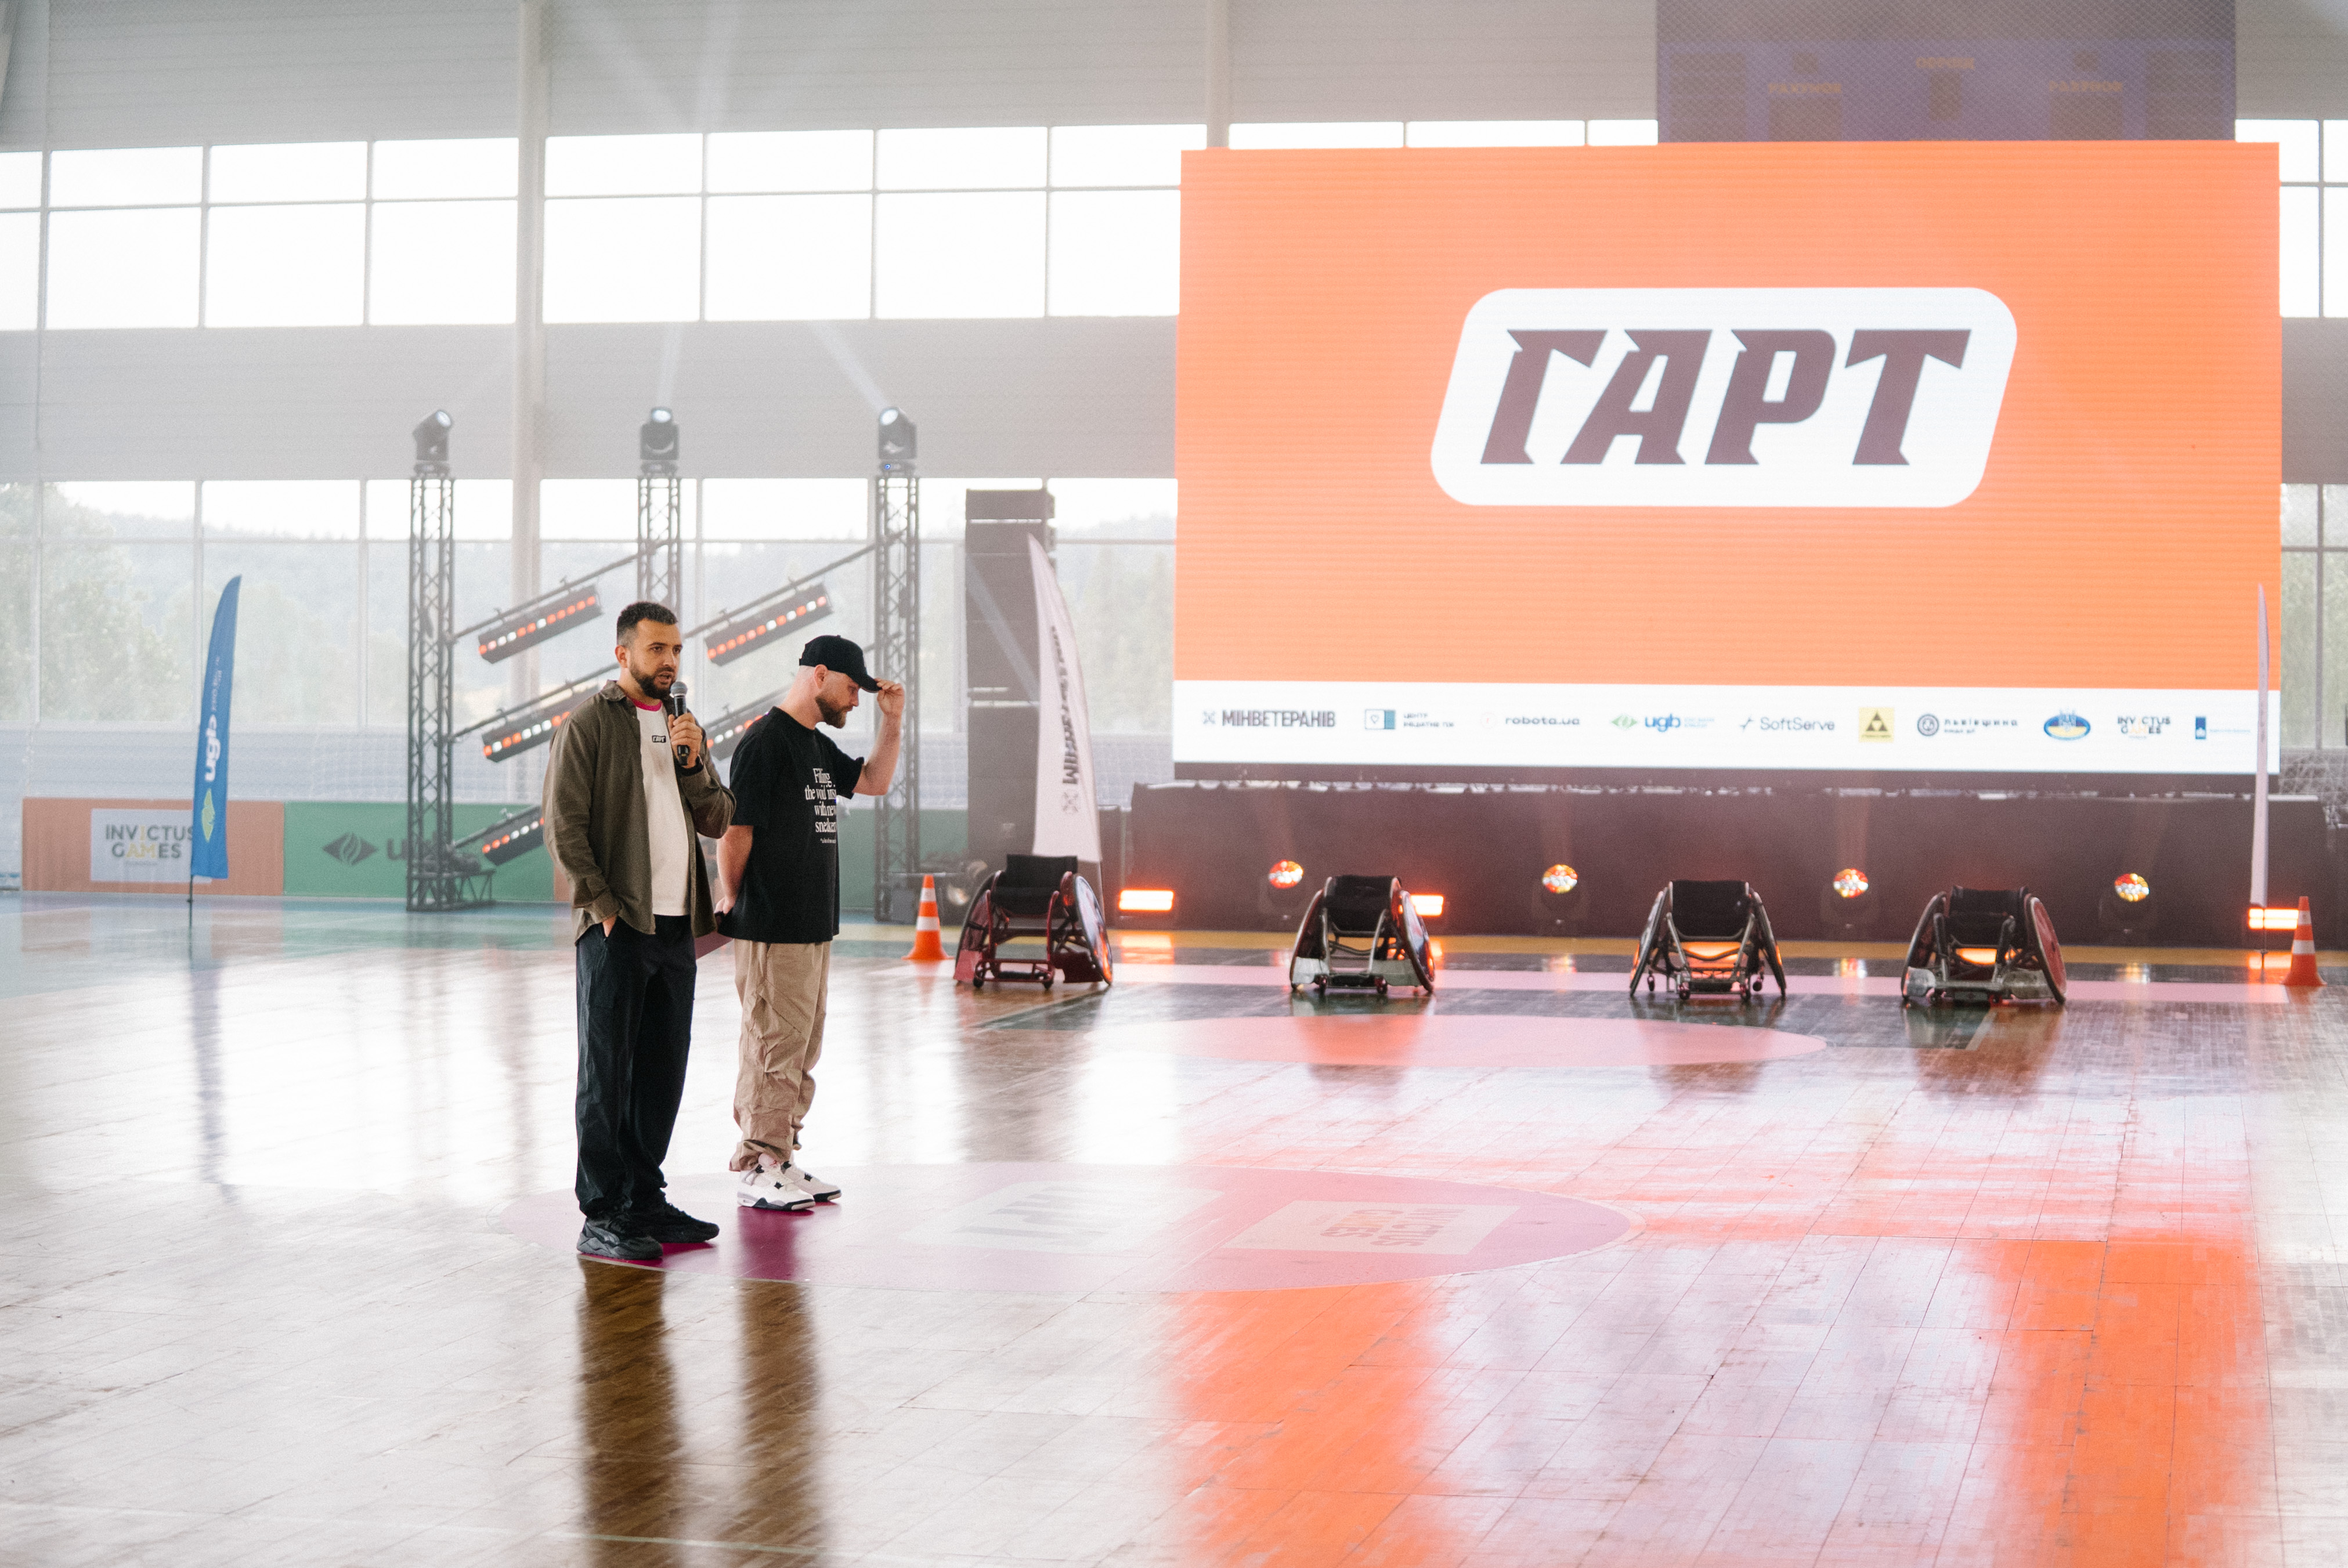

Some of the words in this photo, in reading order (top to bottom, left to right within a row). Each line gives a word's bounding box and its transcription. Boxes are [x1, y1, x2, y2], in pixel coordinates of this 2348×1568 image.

[1479, 329, 1971, 465] ГАРТ
[1222, 710, 1336, 727] МІНВЕТЕРАНІВ
[1505, 716, 1580, 725] robota.ua
[1644, 713, 1681, 732] ugb
[1760, 717, 1835, 731] SoftServe
[204, 714, 222, 782] ugb
[804, 785, 816, 800] the
[816, 785, 827, 800] void
[814, 801, 827, 816] with
[111, 842, 182, 859] GAMES
